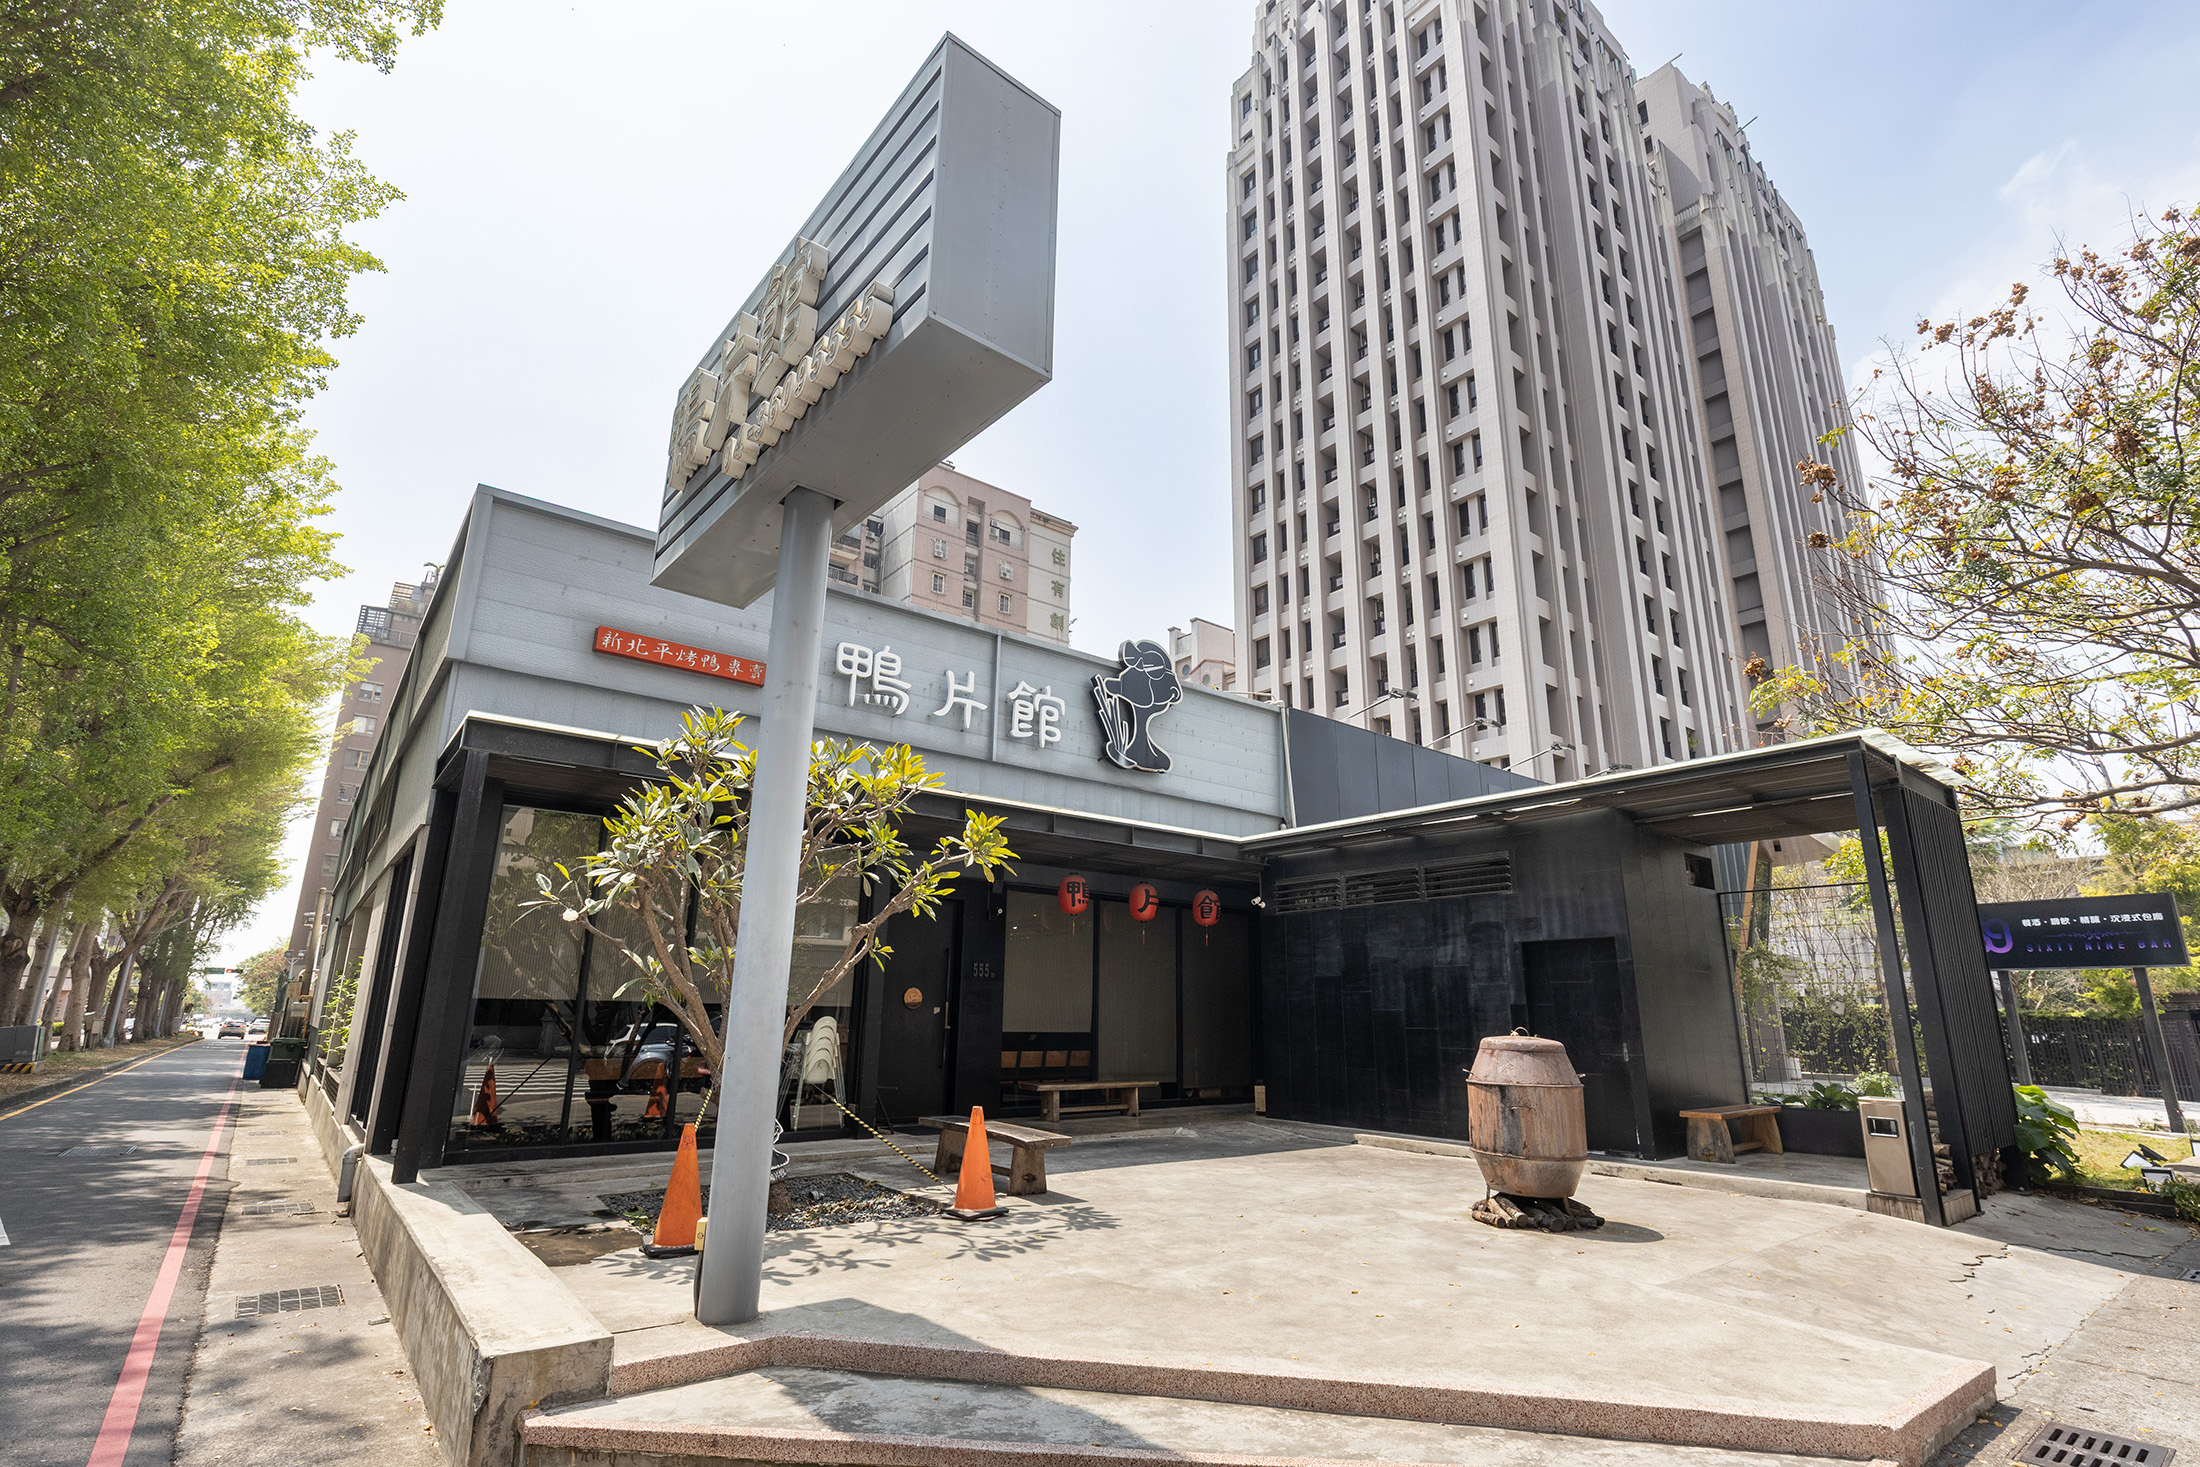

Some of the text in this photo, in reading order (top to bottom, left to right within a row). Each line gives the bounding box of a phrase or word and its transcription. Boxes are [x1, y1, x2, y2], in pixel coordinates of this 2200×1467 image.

[835, 642, 1066, 749] 鴨片館
[2026, 938, 2172, 953] SIXTY NINE BAR
[973, 963, 990, 977] 555
